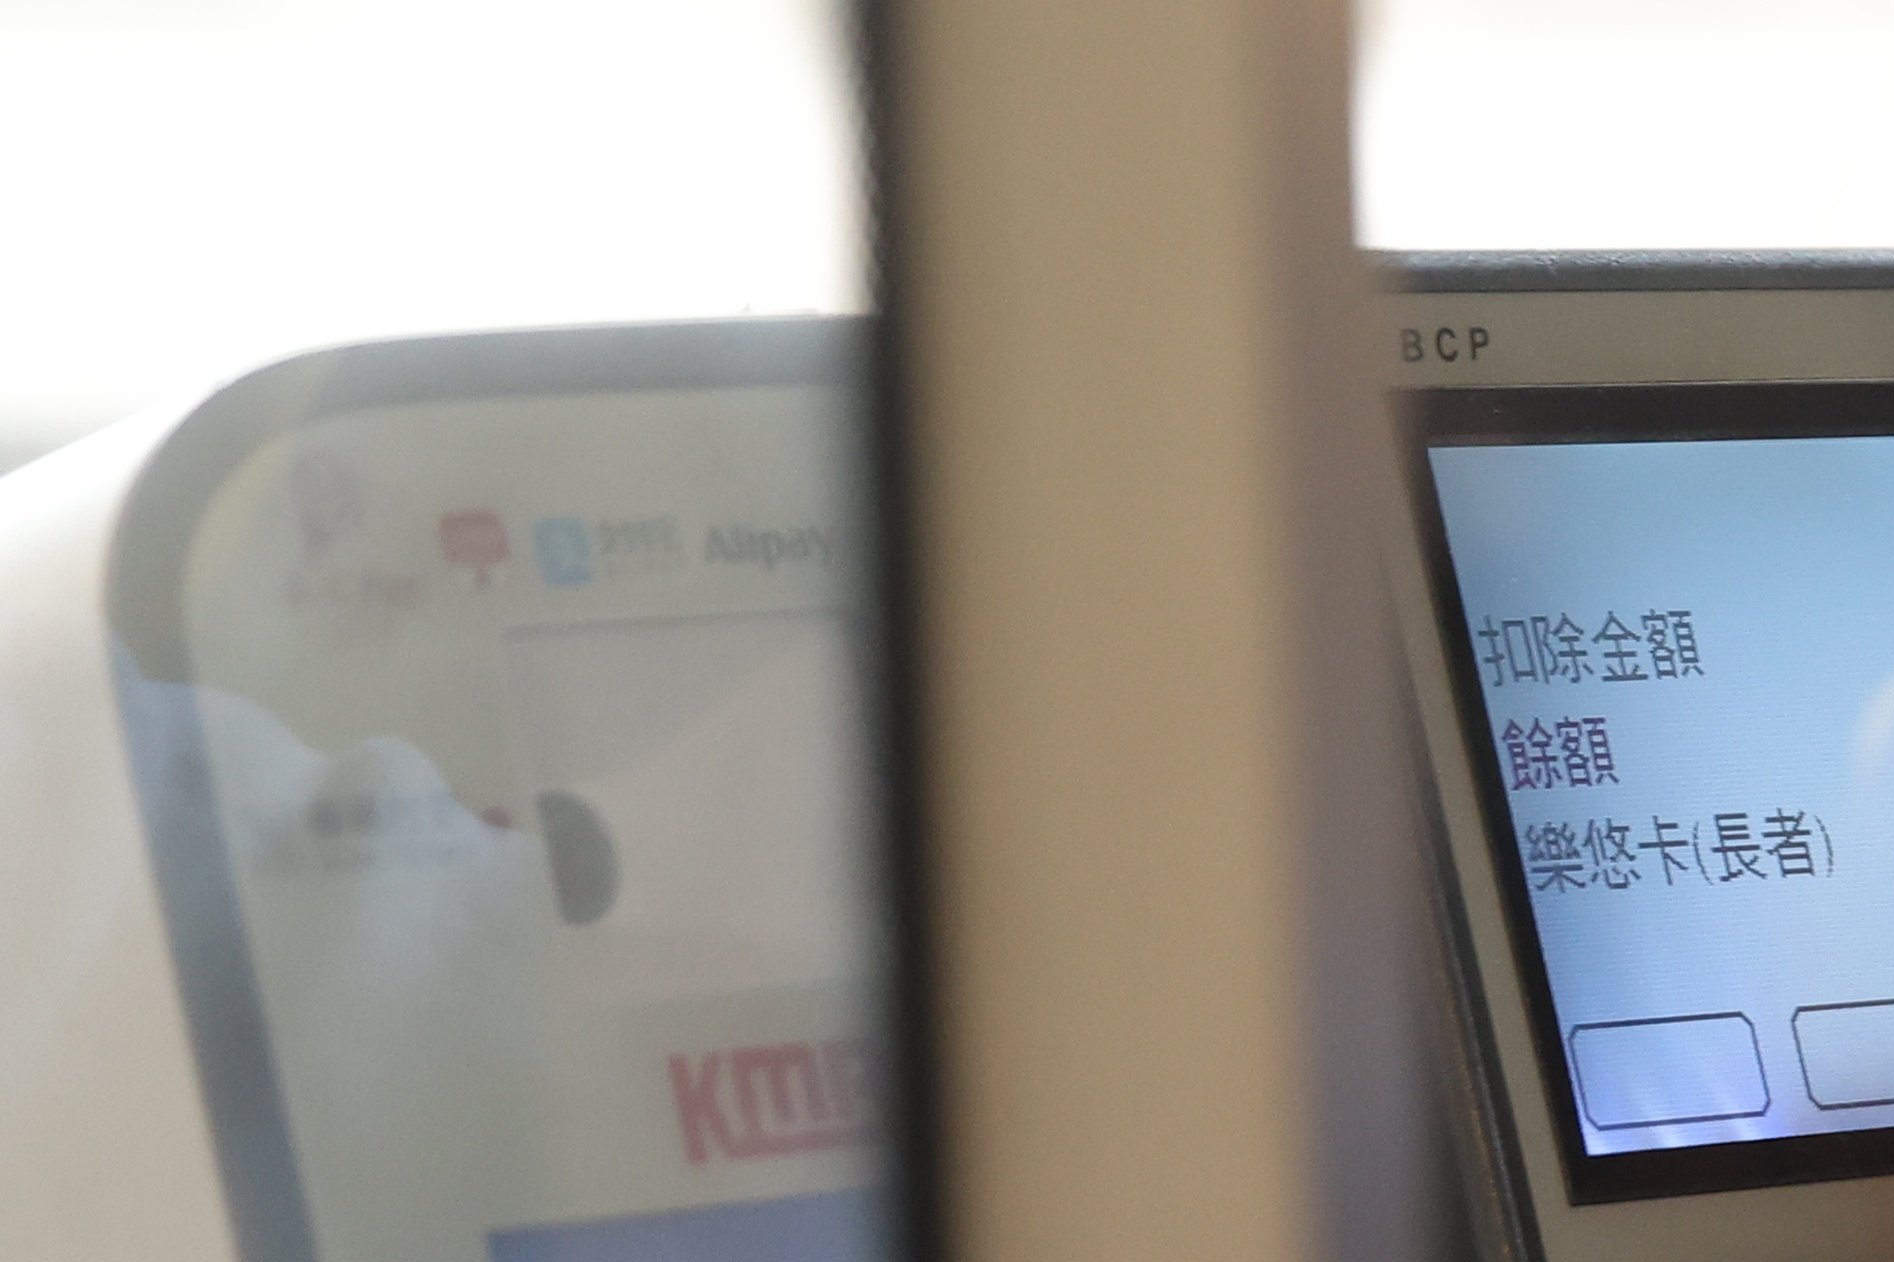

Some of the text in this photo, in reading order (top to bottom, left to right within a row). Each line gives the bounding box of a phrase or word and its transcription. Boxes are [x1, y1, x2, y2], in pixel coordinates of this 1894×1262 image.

[1477, 608, 1705, 687] 扣除金額
[1501, 716, 1620, 790] 餘額
[1525, 807, 1835, 893] 樂悠卡(長者)
